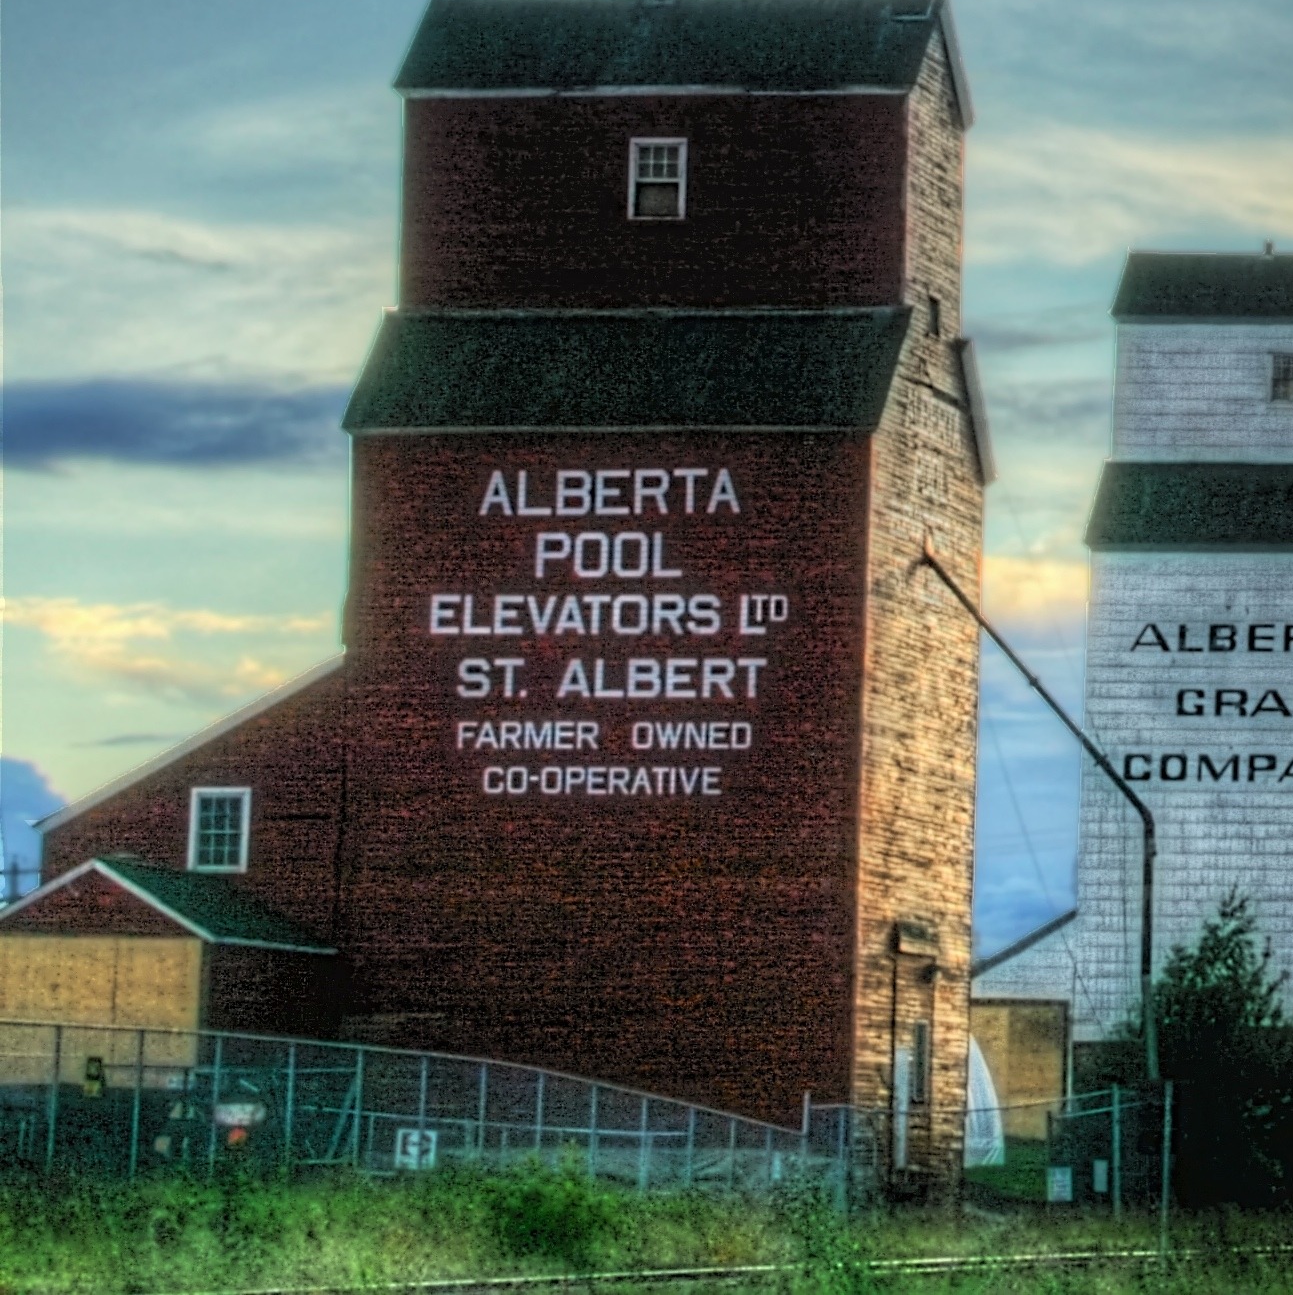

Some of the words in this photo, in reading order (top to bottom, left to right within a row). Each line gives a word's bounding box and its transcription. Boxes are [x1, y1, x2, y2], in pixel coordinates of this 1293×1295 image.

[479, 469, 741, 516] ALBERTA
[535, 532, 683, 579] POOL
[430, 594, 721, 635] ELEVATORS
[457, 658, 528, 698] ST.
[556, 658, 768, 698] ALBERT
[457, 721, 599, 750] FARMER
[632, 721, 751, 749] OWNED
[483, 766, 722, 795] CO-OPERATIVE
